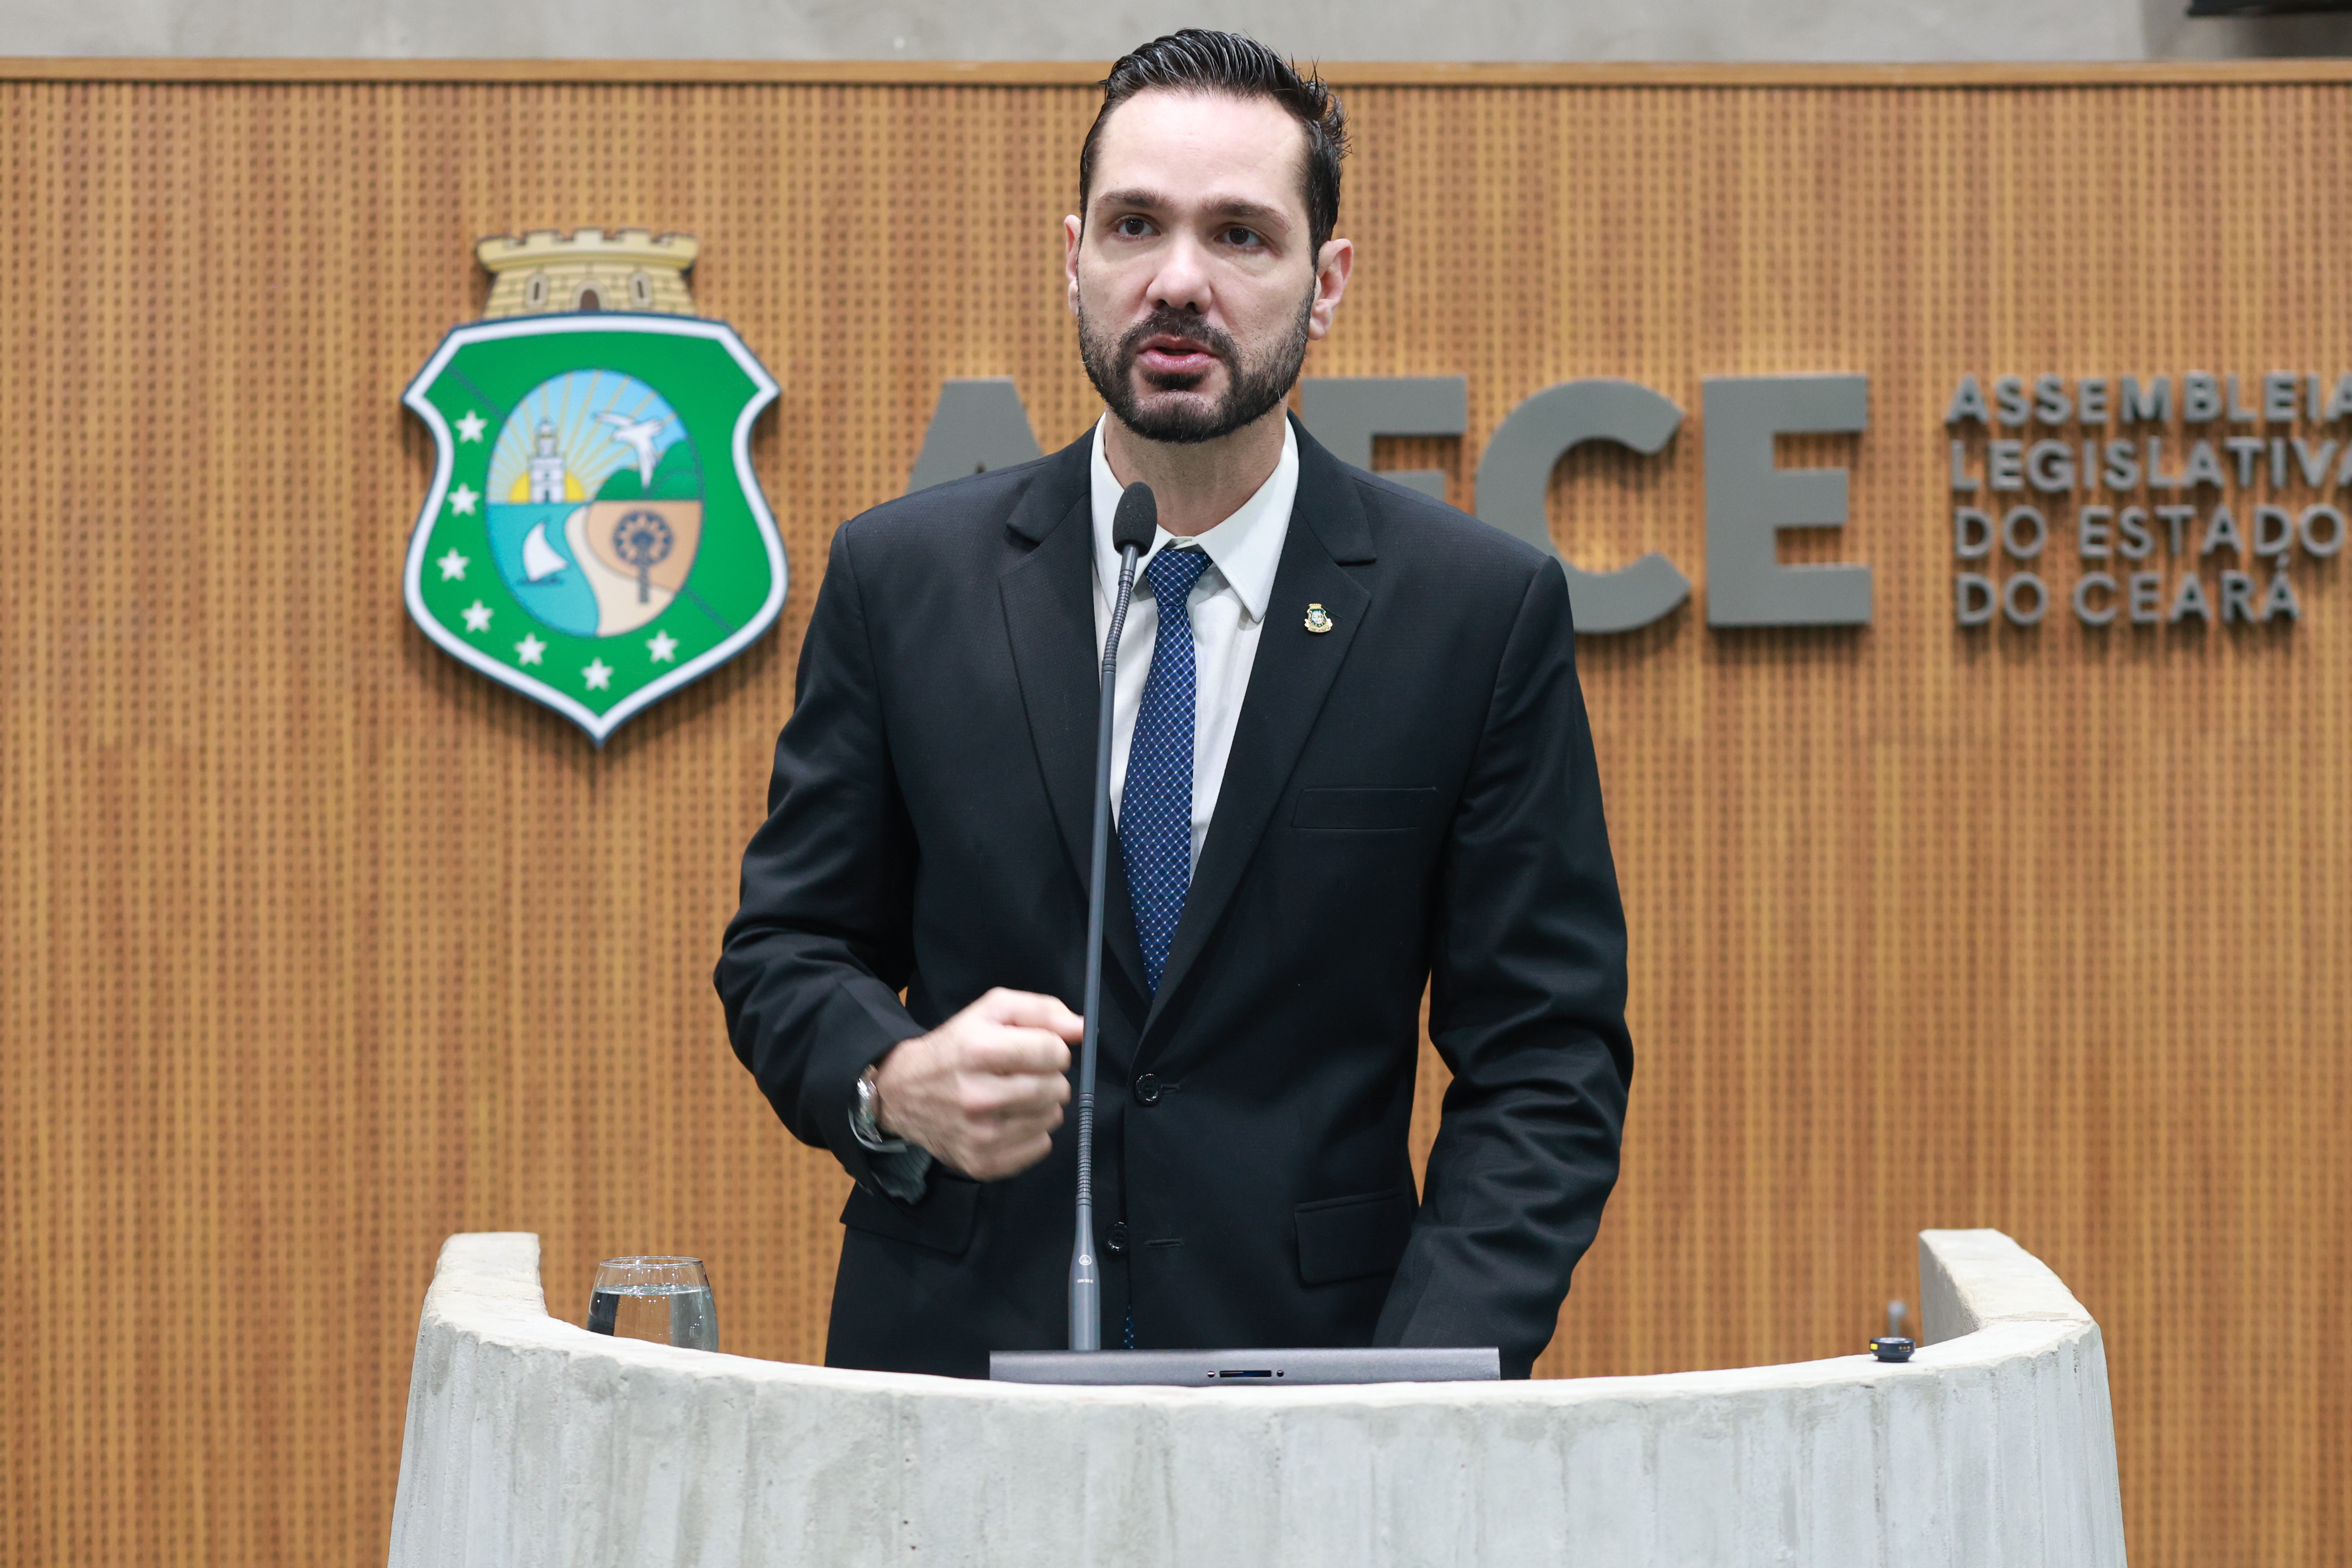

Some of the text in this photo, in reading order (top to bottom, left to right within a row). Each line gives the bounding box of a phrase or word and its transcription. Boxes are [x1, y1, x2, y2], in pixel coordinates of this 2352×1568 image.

[1954, 503, 2347, 559] DO ESTADO
[1955, 554, 2301, 626] DO CEARÁ
